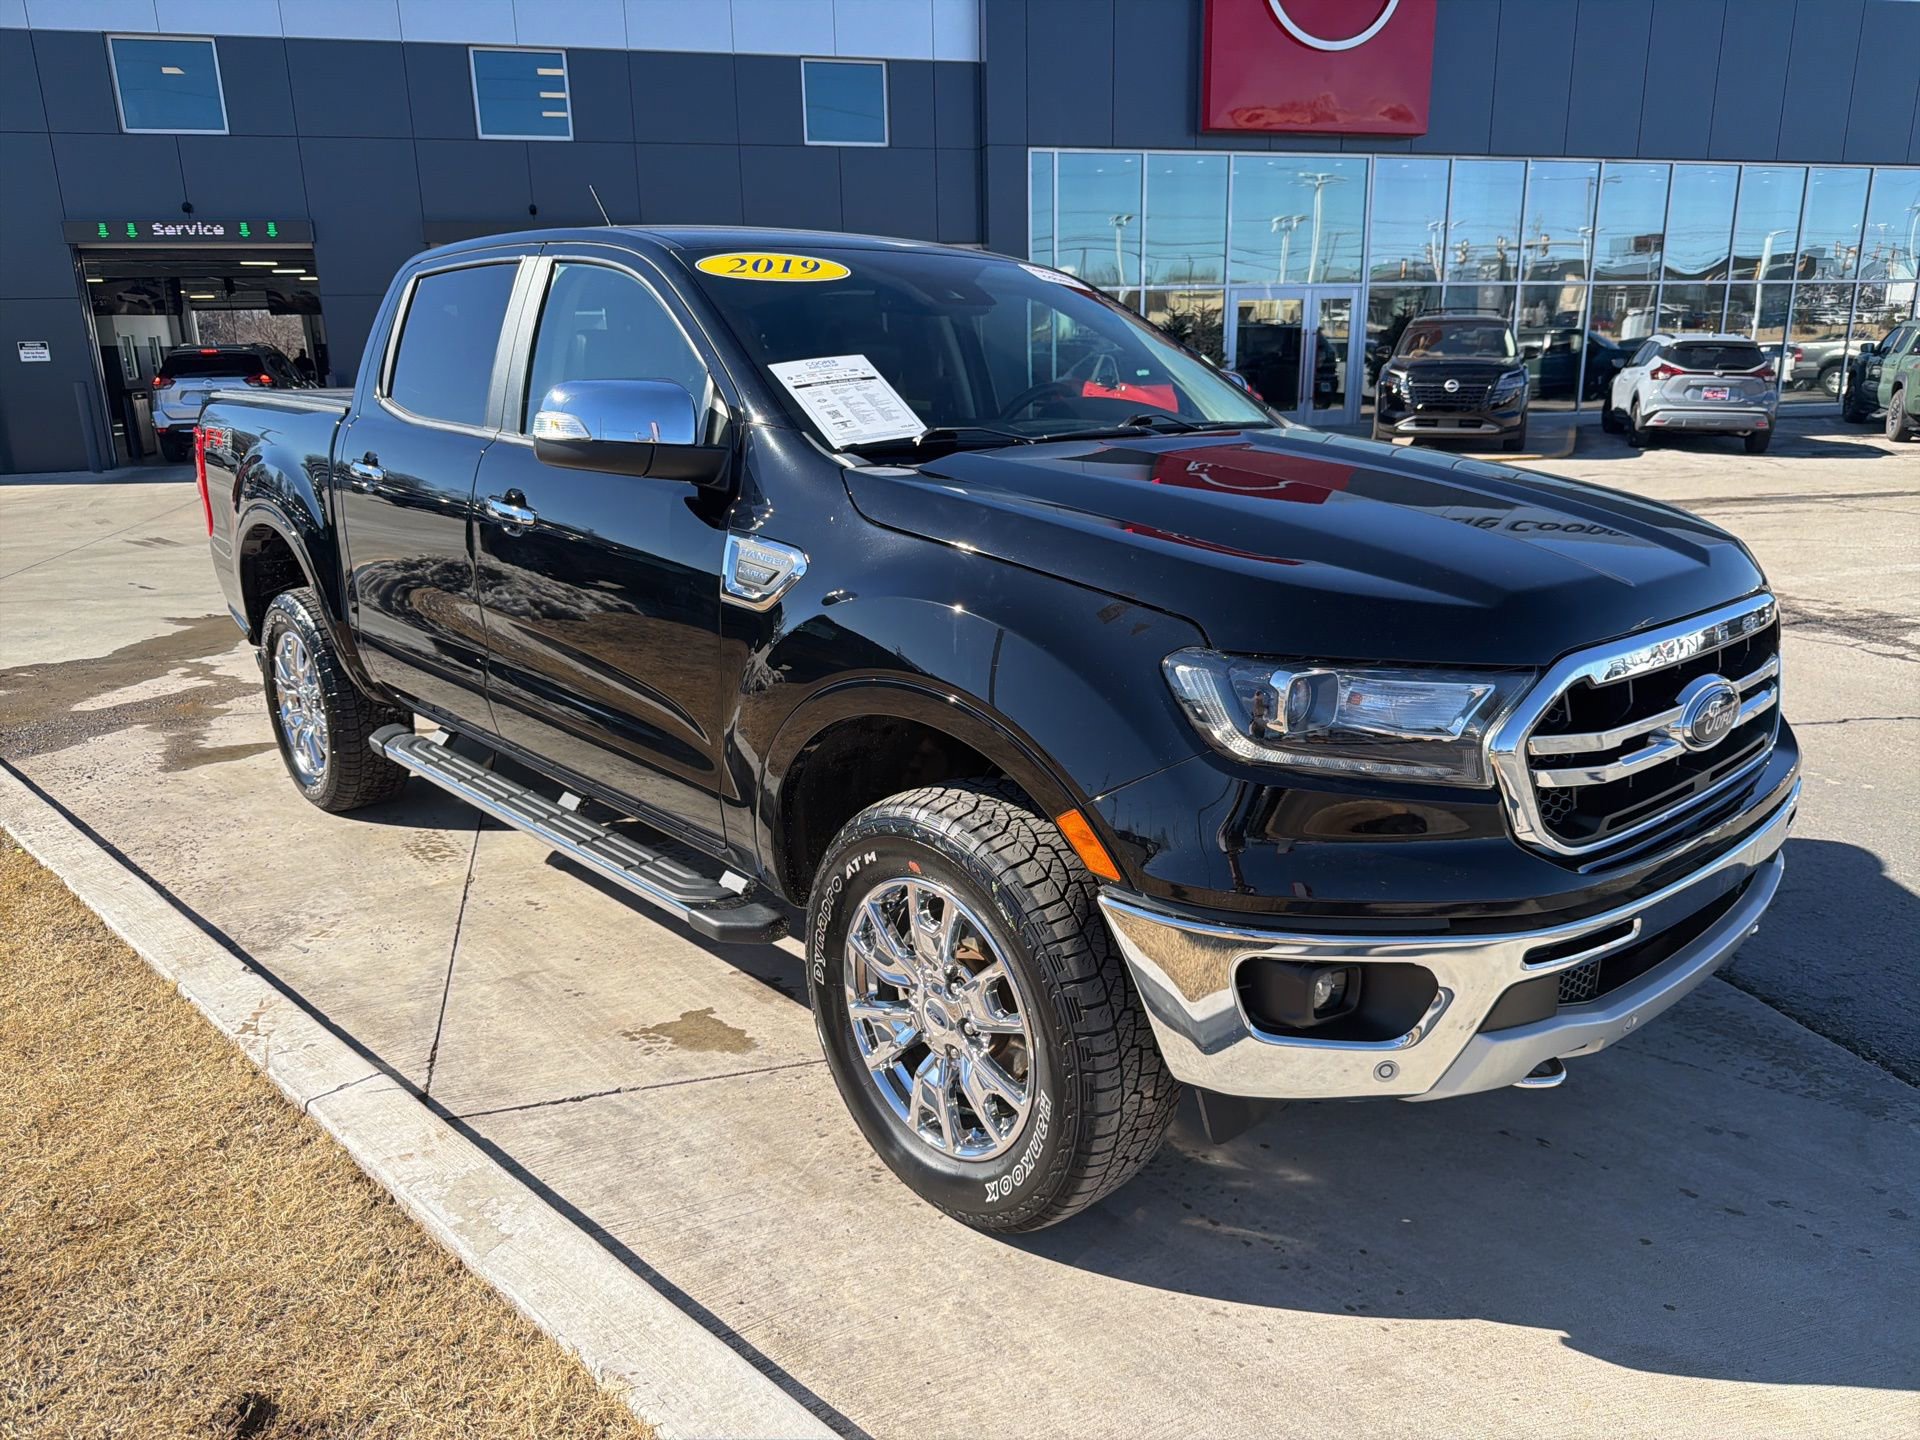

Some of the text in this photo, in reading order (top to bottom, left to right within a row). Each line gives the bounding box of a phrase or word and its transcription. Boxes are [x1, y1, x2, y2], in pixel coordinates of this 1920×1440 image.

[152, 221, 225, 236] Service
[726, 257, 821, 275] 2019
[205, 425, 232, 453] FX4
[739, 547, 789, 568] RANGER
[1696, 700, 1735, 735] Ford
